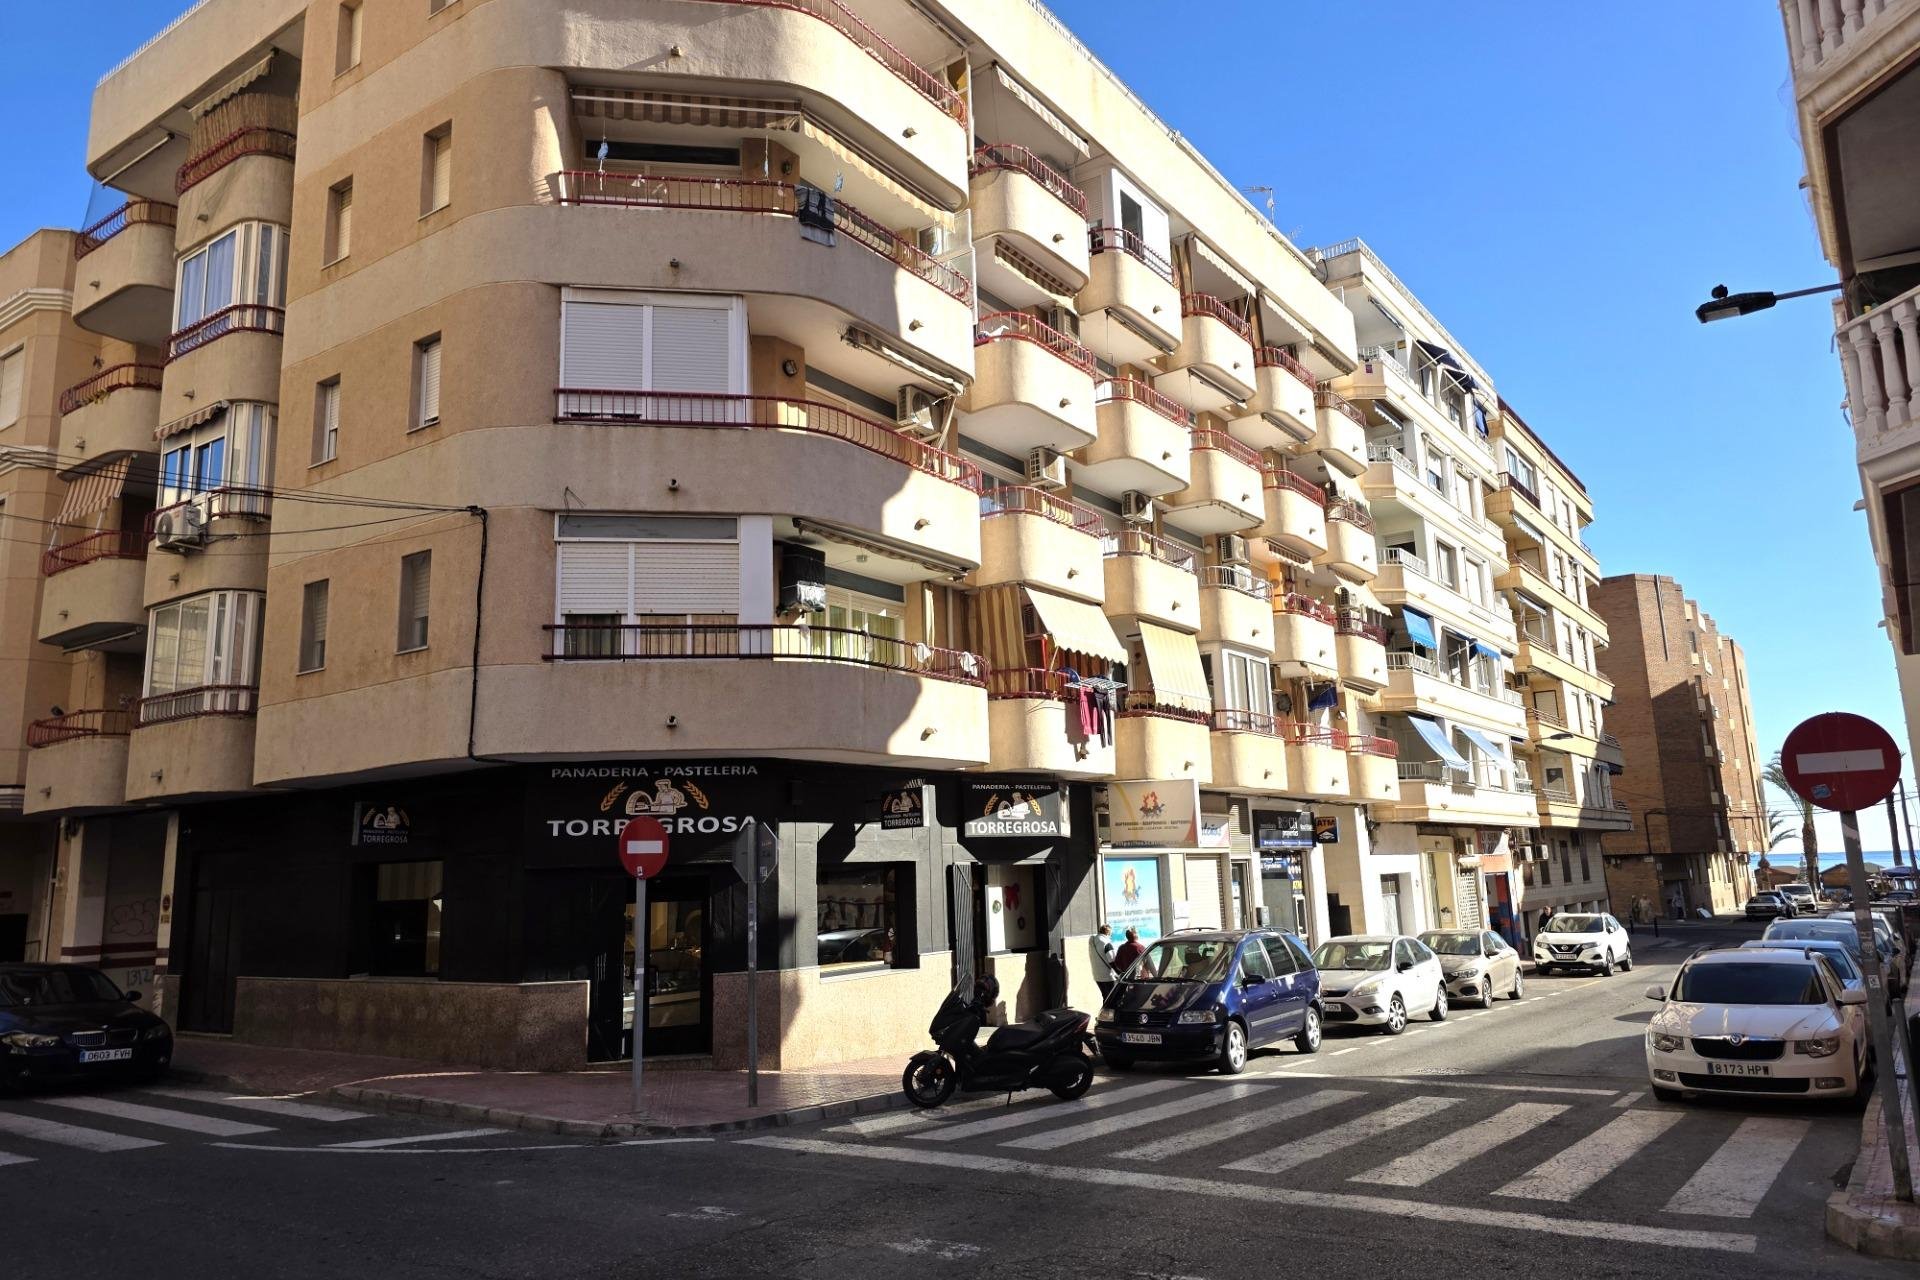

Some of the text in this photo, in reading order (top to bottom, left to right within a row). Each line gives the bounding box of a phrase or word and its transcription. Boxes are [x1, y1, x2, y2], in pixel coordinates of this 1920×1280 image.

[551, 767, 648, 778] PANADERIA
[664, 765, 758, 776] PASTELERIA
[546, 816, 756, 837] TORRGROSA
[884, 817, 921, 827] TORREGROSA
[968, 821, 1058, 834] TORREGROSA
[1317, 819, 1335, 827] ATM
[363, 835, 408, 844] TORREGROSA
[88, 1049, 131, 1061] 0603 FVH
[1715, 1063, 1744, 1074] 8173
